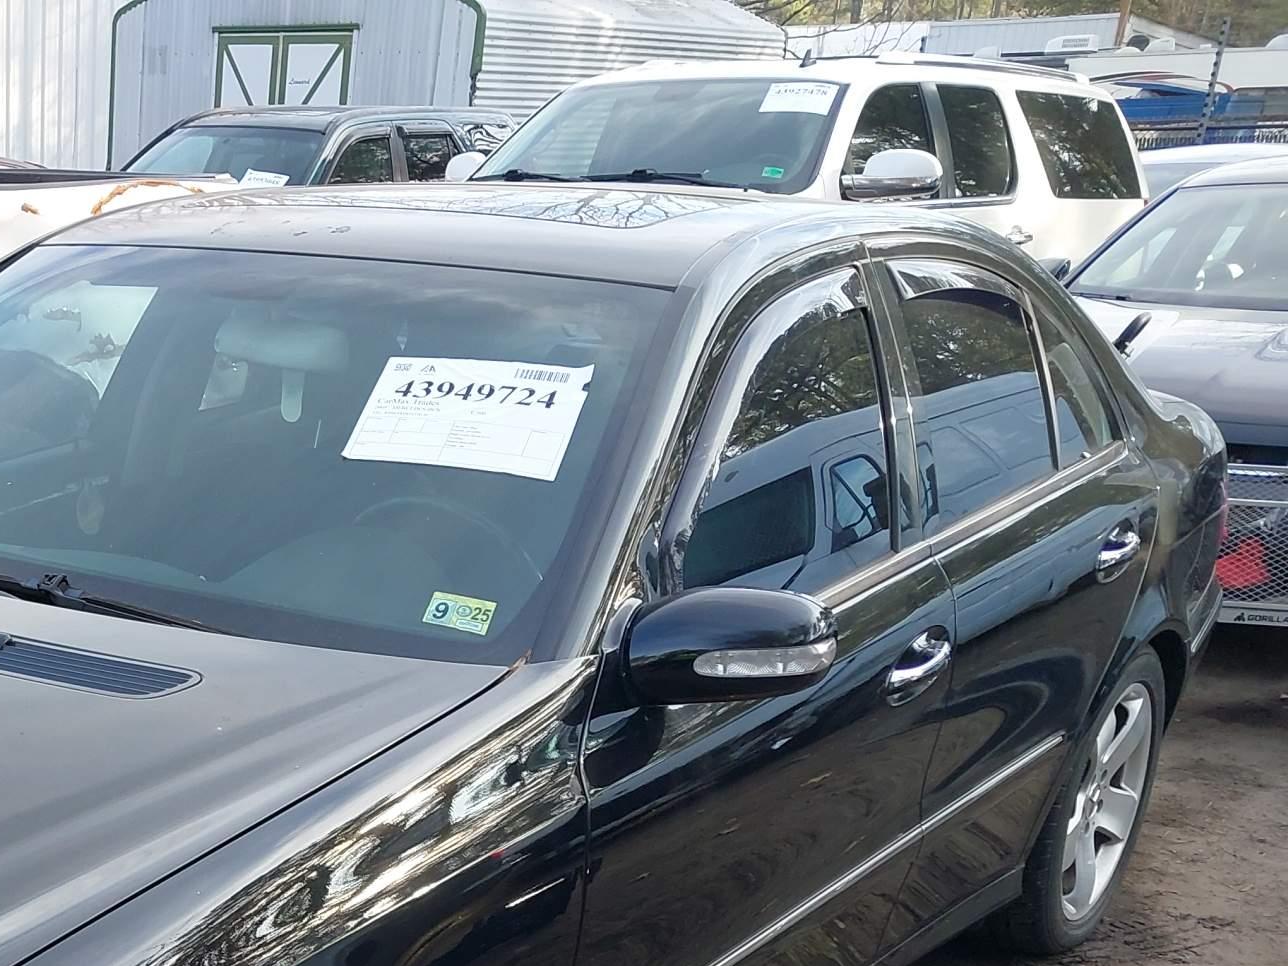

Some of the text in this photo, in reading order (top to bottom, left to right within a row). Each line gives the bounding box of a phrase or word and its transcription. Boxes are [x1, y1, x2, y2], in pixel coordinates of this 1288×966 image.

[394, 380, 558, 409] 43949724
[432, 602, 492, 622] 9 25
